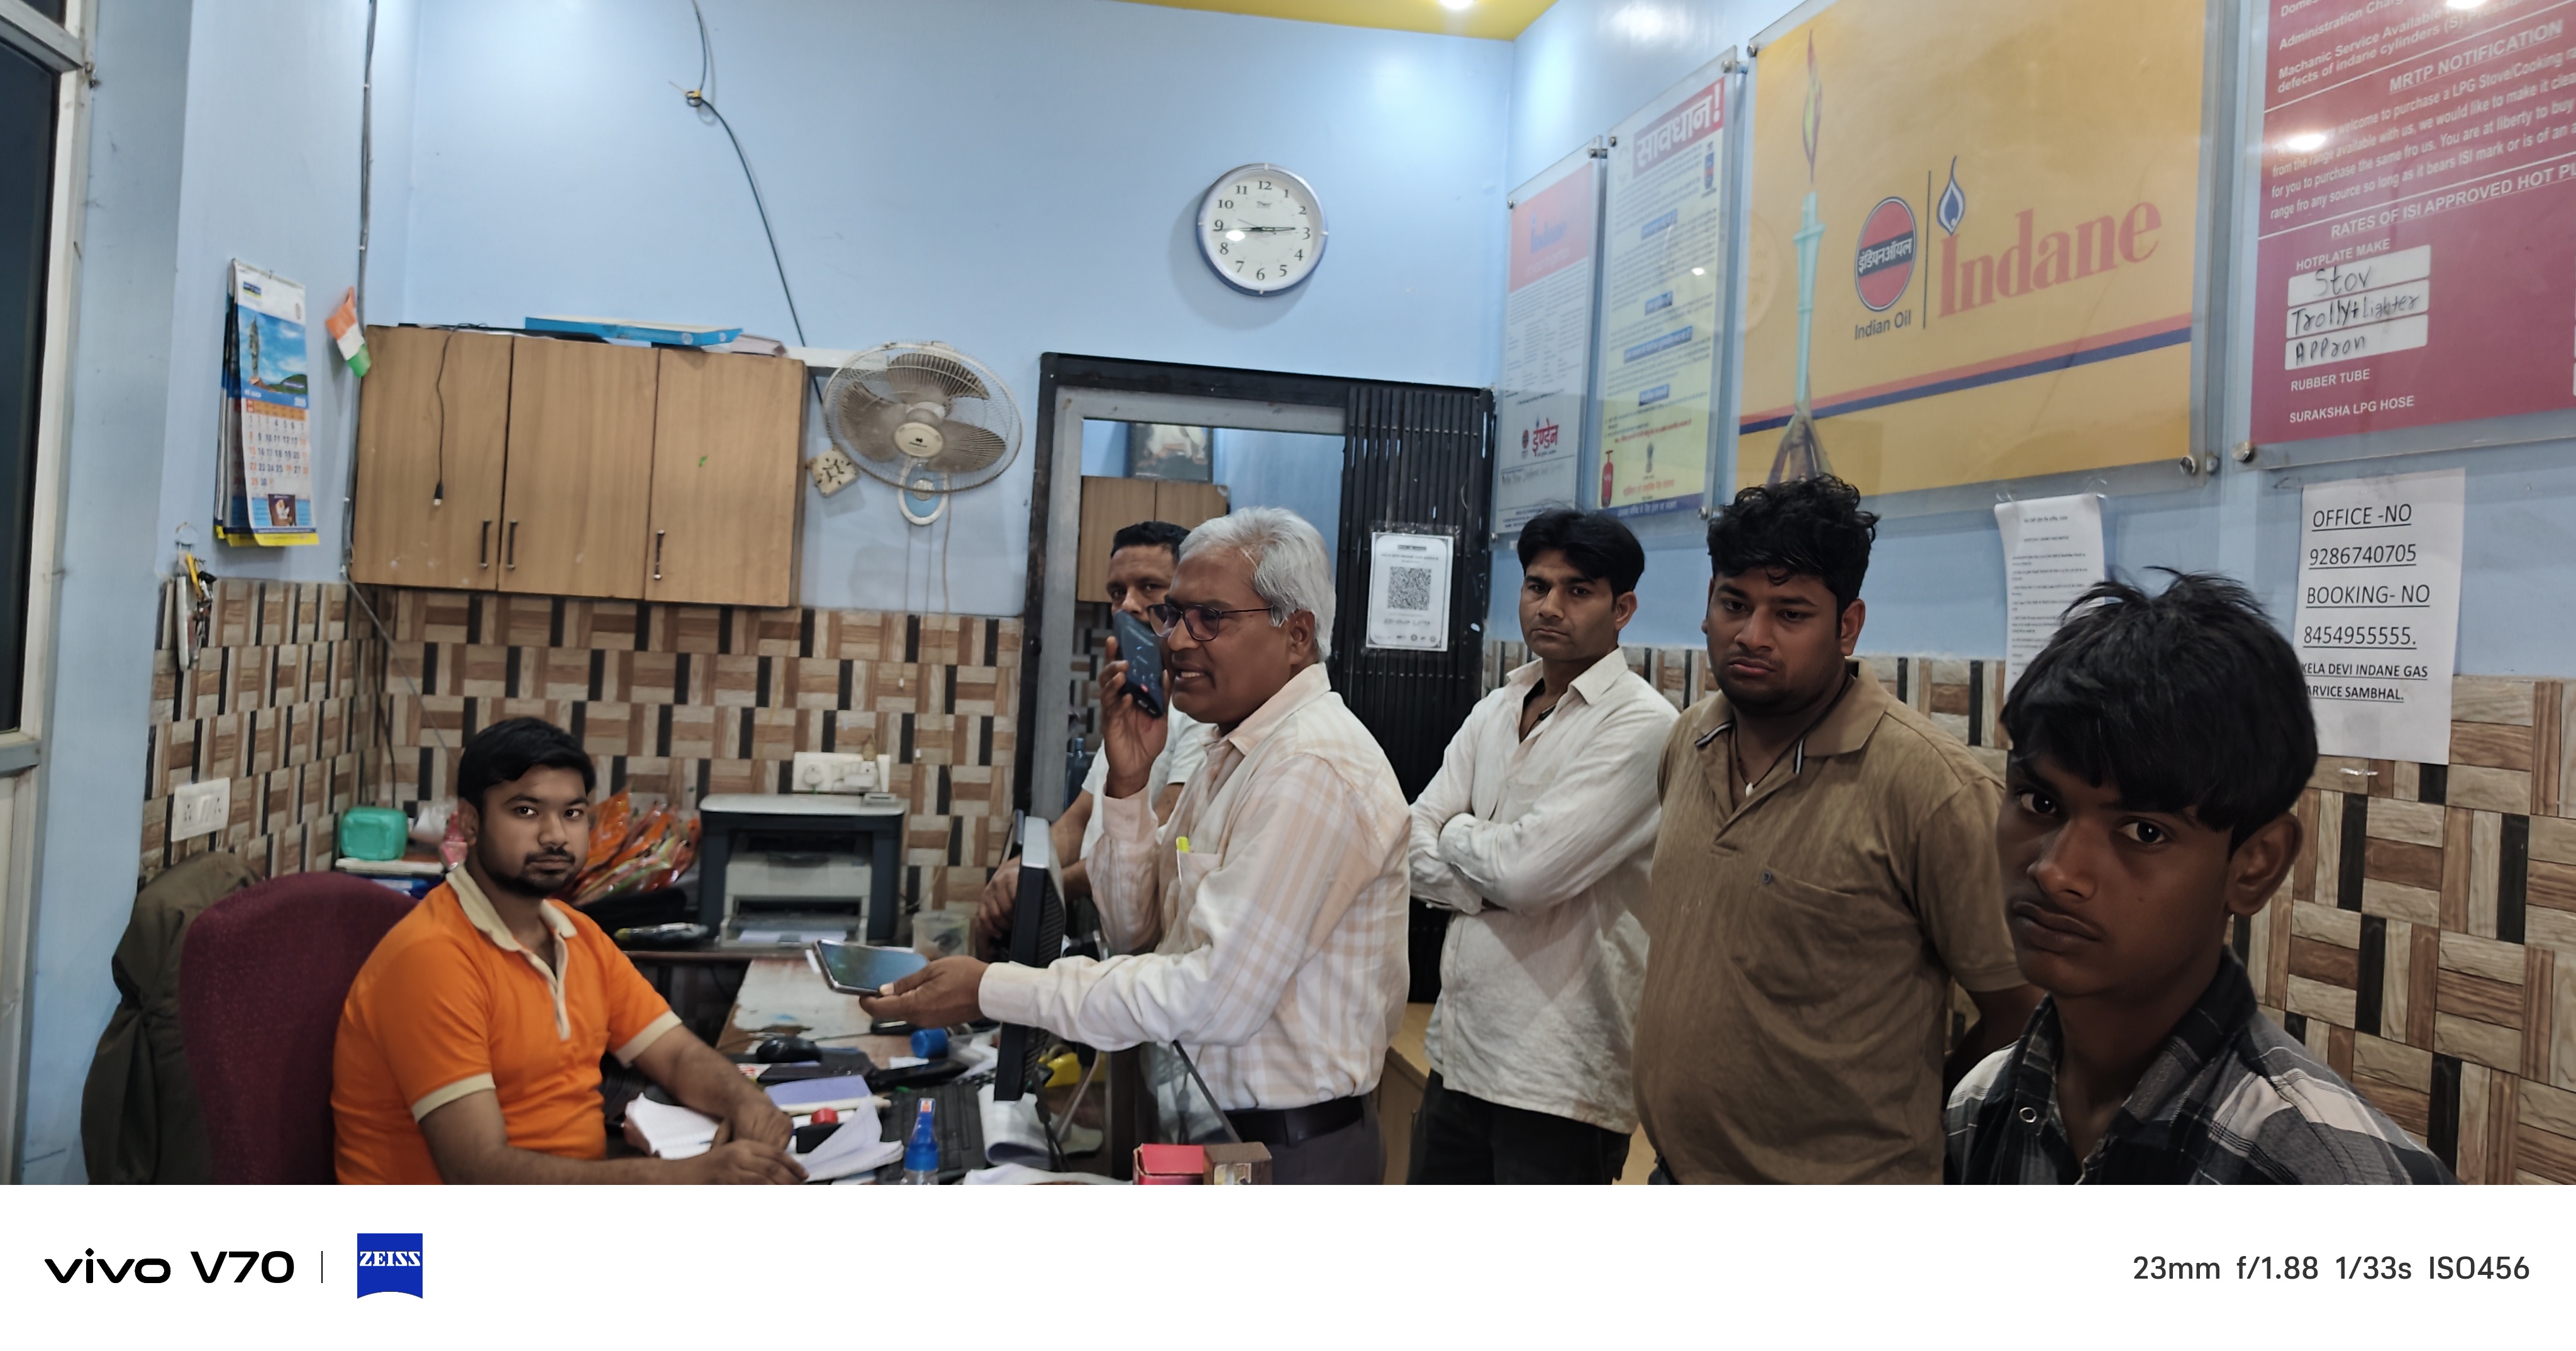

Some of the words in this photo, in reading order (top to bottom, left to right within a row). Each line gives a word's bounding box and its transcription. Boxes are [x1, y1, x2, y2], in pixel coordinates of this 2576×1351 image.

[2279, 8, 2362, 50] Administration
[2279, 51, 2332, 79] Machanic
[2335, 33, 2379, 57] Service
[2382, 9, 2442, 39] Available
[2278, 71, 2318, 93] defects
[2322, 62, 2334, 77] of
[2336, 49, 2377, 71] indane
[2380, 25, 2440, 55] cylinders
[2390, 65, 2434, 92] MRTP
[2438, 19, 2563, 75] NOTIFICATION
[2338, 113, 2379, 134] welcome
[2382, 109, 2390, 121] to
[2394, 92, 2440, 120] purchase
[2443, 90, 2450, 100] a
[2453, 78, 2475, 97] LPG
[2273, 163, 2292, 177] from
[2294, 157, 2307, 174] the
[2309, 149, 2334, 166] range
[2336, 135, 2377, 157] available
[2379, 126, 2399, 144] with
[2419, 118, 2433, 130] we
[2436, 104, 2467, 125] would
[2470, 99, 2489, 114] like
[2492, 95, 2504, 108] to
[2506, 84, 2536, 104] make
[2540, 79, 2550, 93] it
[2272, 185, 2287, 198] for
[2285, 182, 2301, 197] you
[2304, 177, 2312, 189] to
[2315, 164, 2357, 187] purchase
[2358, 158, 2373, 172] the
[2376, 150, 2401, 167] same
[2404, 144, 2418, 157] fro
[2440, 133, 2460, 148] You
[2463, 127, 2479, 141] are
[2483, 123, 2493, 135] at
[2497, 110, 2533, 131] liberty
[2536, 106, 2547, 119] to
[2551, 98, 2575, 114] buy
[2270, 205, 2294, 220] range
[2297, 199, 2309, 212] fro
[2311, 194, 2327, 208] any
[2329, 186, 2361, 203] source
[2363, 181, 2375, 193] so
[2378, 172, 2399, 188] long
[2402, 169, 2414, 182] as
[2417, 164, 2424, 178] it
[2426, 158, 2455, 175] bears
[2459, 149, 2472, 165] ISI
[2476, 142, 2504, 161] mark
[2507, 138, 2519, 152] or
[2523, 133, 2533, 148] is
[2536, 127, 2550, 143] of
[2552, 125, 2567, 139] an
[1235, 185, 1247, 195] 11
[1258, 181, 1272, 191] 12
[1284, 189, 1289, 198] 1
[1218, 199, 1233, 209] 10
[1298, 206, 1307, 215] 2
[2331, 215, 2375, 238] RATES
[2379, 208, 2399, 225] OF
[2403, 203, 2421, 219] ISI
[2424, 179, 2512, 214] APPROVED
[2517, 167, 2554, 190] HOT
[1214, 220, 1224, 231] 9
[1302, 227, 1311, 240] 3
[1219, 242, 1229, 255] 8
[1294, 249, 1303, 261] 4
[2296, 248, 2353, 271] HOTPLATE
[2357, 238, 2390, 258] MAKE
[1235, 260, 1245, 273] 7
[1938, 201, 2162, 318] Indane
[1255, 268, 1265, 281] 6
[1279, 264, 1288, 277] 5
[1855, 318, 1890, 340] Indian
[1894, 309, 1911, 329] Oil
[2290, 374, 2336, 392] RUBBER
[2340, 368, 2370, 383] TUBE
[2289, 405, 2350, 423] SURAKSHA
[2353, 401, 2376, 415] LPG
[2380, 395, 2414, 411] HOSE
[2312, 506, 2373, 528] OFFICE
[2377, 503, 2412, 523] -NO
[2309, 544, 2416, 566] 9286740705
[2307, 585, 2396, 604] BOOKING-
[2401, 584, 2430, 603] NO
[2303, 626, 2416, 645] 8454955555.
[2328, 664, 2353, 676] DEVI
[2356, 664, 2400, 677] INDANE
[2404, 665, 2428, 677] GAS
[2306, 685, 2343, 698] ARVICE
[2345, 687, 2404, 700] SAMBHAL.
